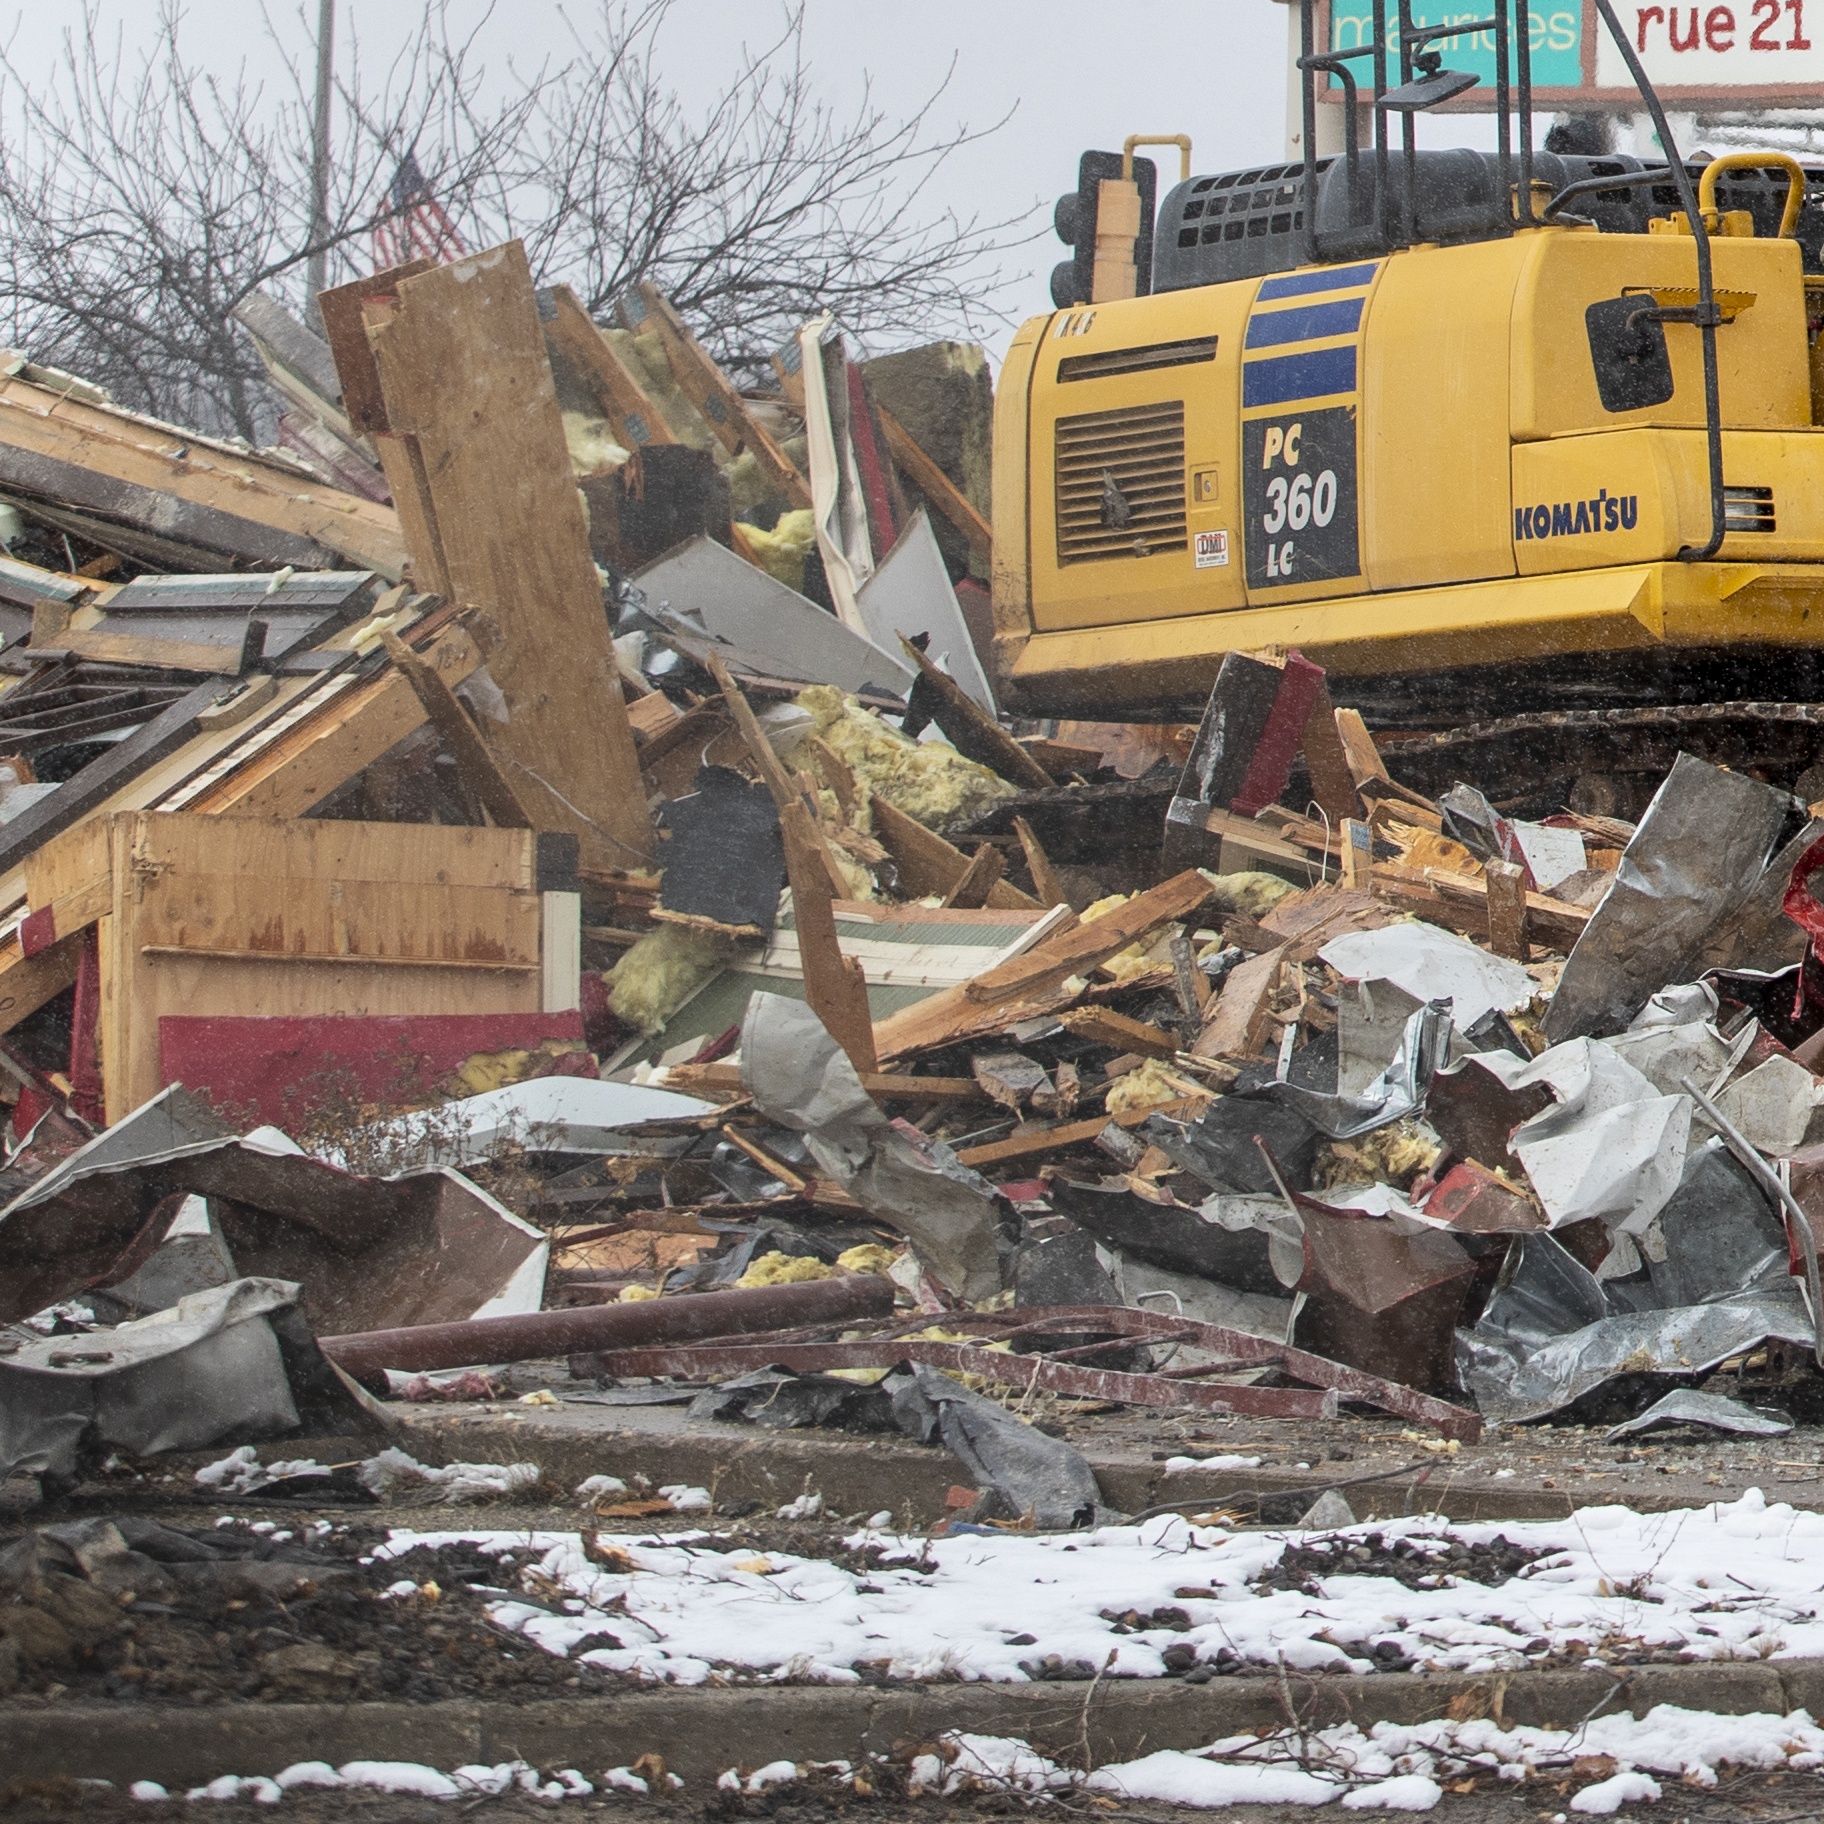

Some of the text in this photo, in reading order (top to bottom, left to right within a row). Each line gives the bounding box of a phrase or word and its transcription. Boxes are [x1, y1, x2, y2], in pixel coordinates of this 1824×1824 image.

[1637, 5, 1736, 54] rue
[1262, 423, 1302, 469] PC
[1263, 469, 1337, 534] 360
[1515, 488, 1638, 541] KOMATSU
[1267, 541, 1294, 577] LC
